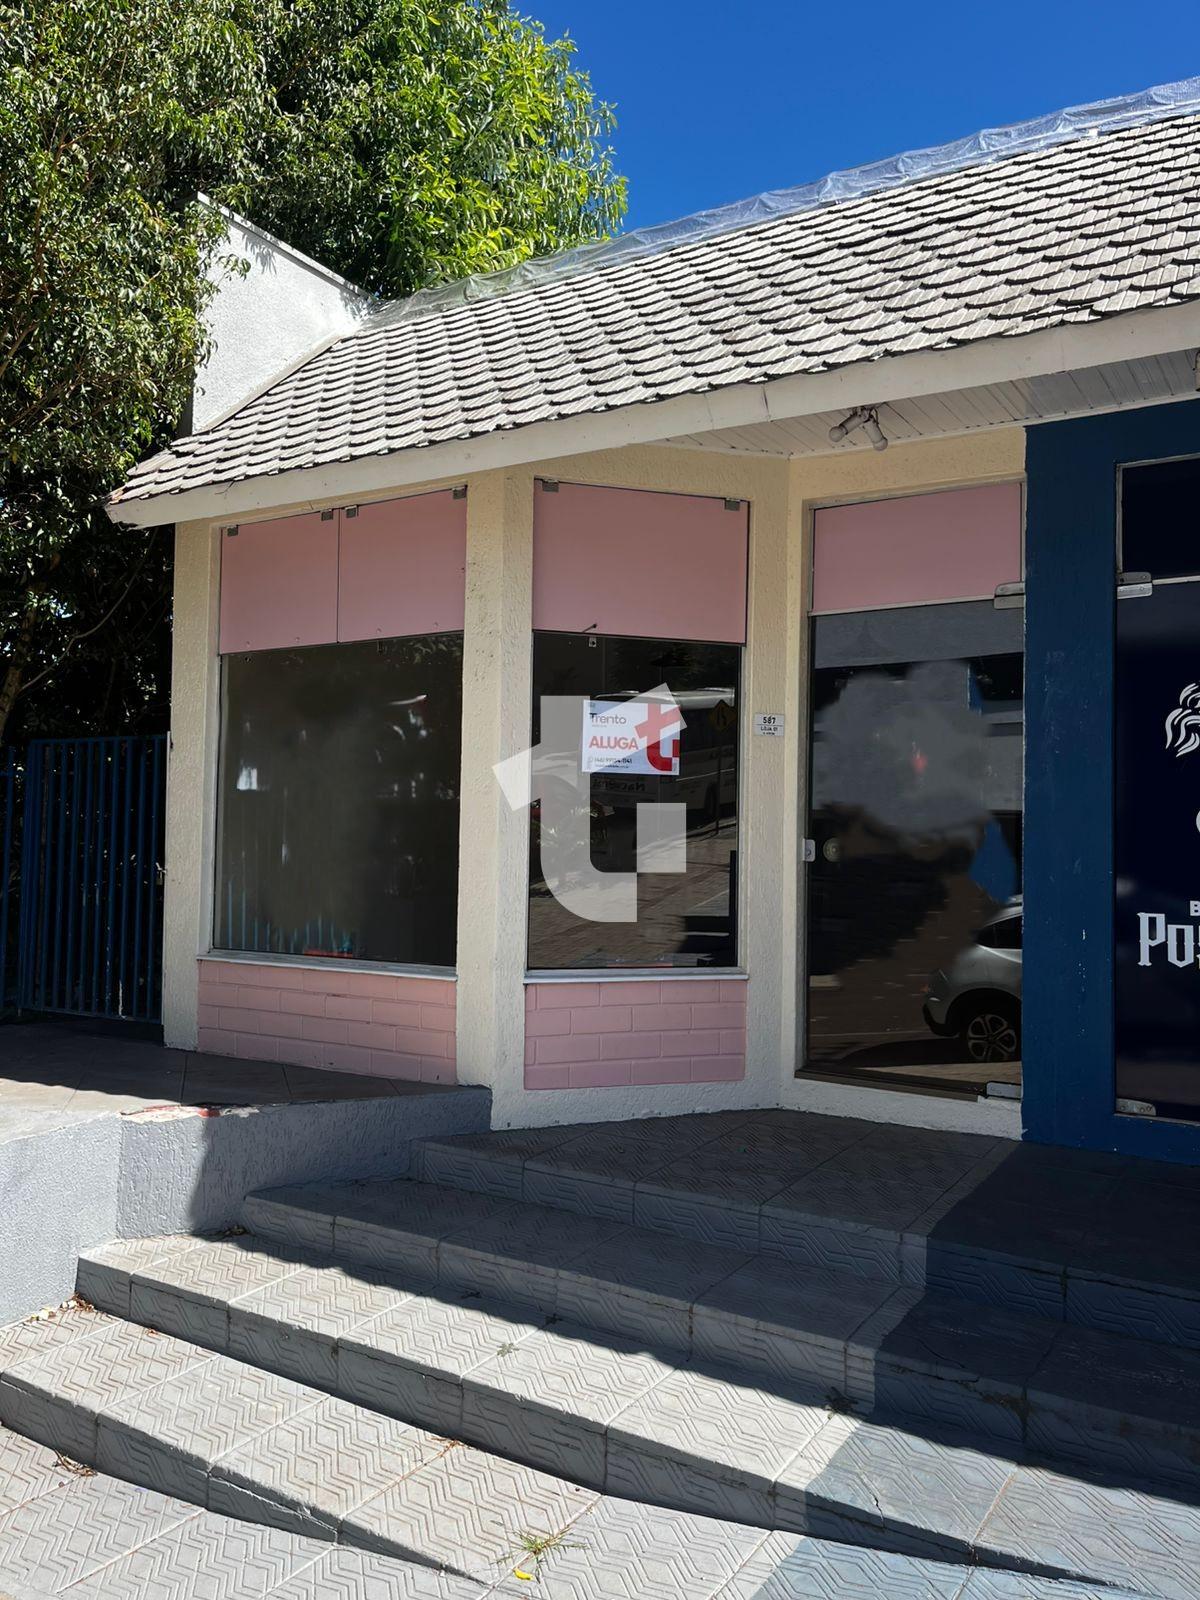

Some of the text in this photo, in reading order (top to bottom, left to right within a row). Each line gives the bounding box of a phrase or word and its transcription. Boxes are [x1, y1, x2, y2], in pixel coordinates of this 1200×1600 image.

[589, 712, 627, 725] Trento
[763, 716, 776, 724] 587
[589, 736, 639, 750] ALUGA
